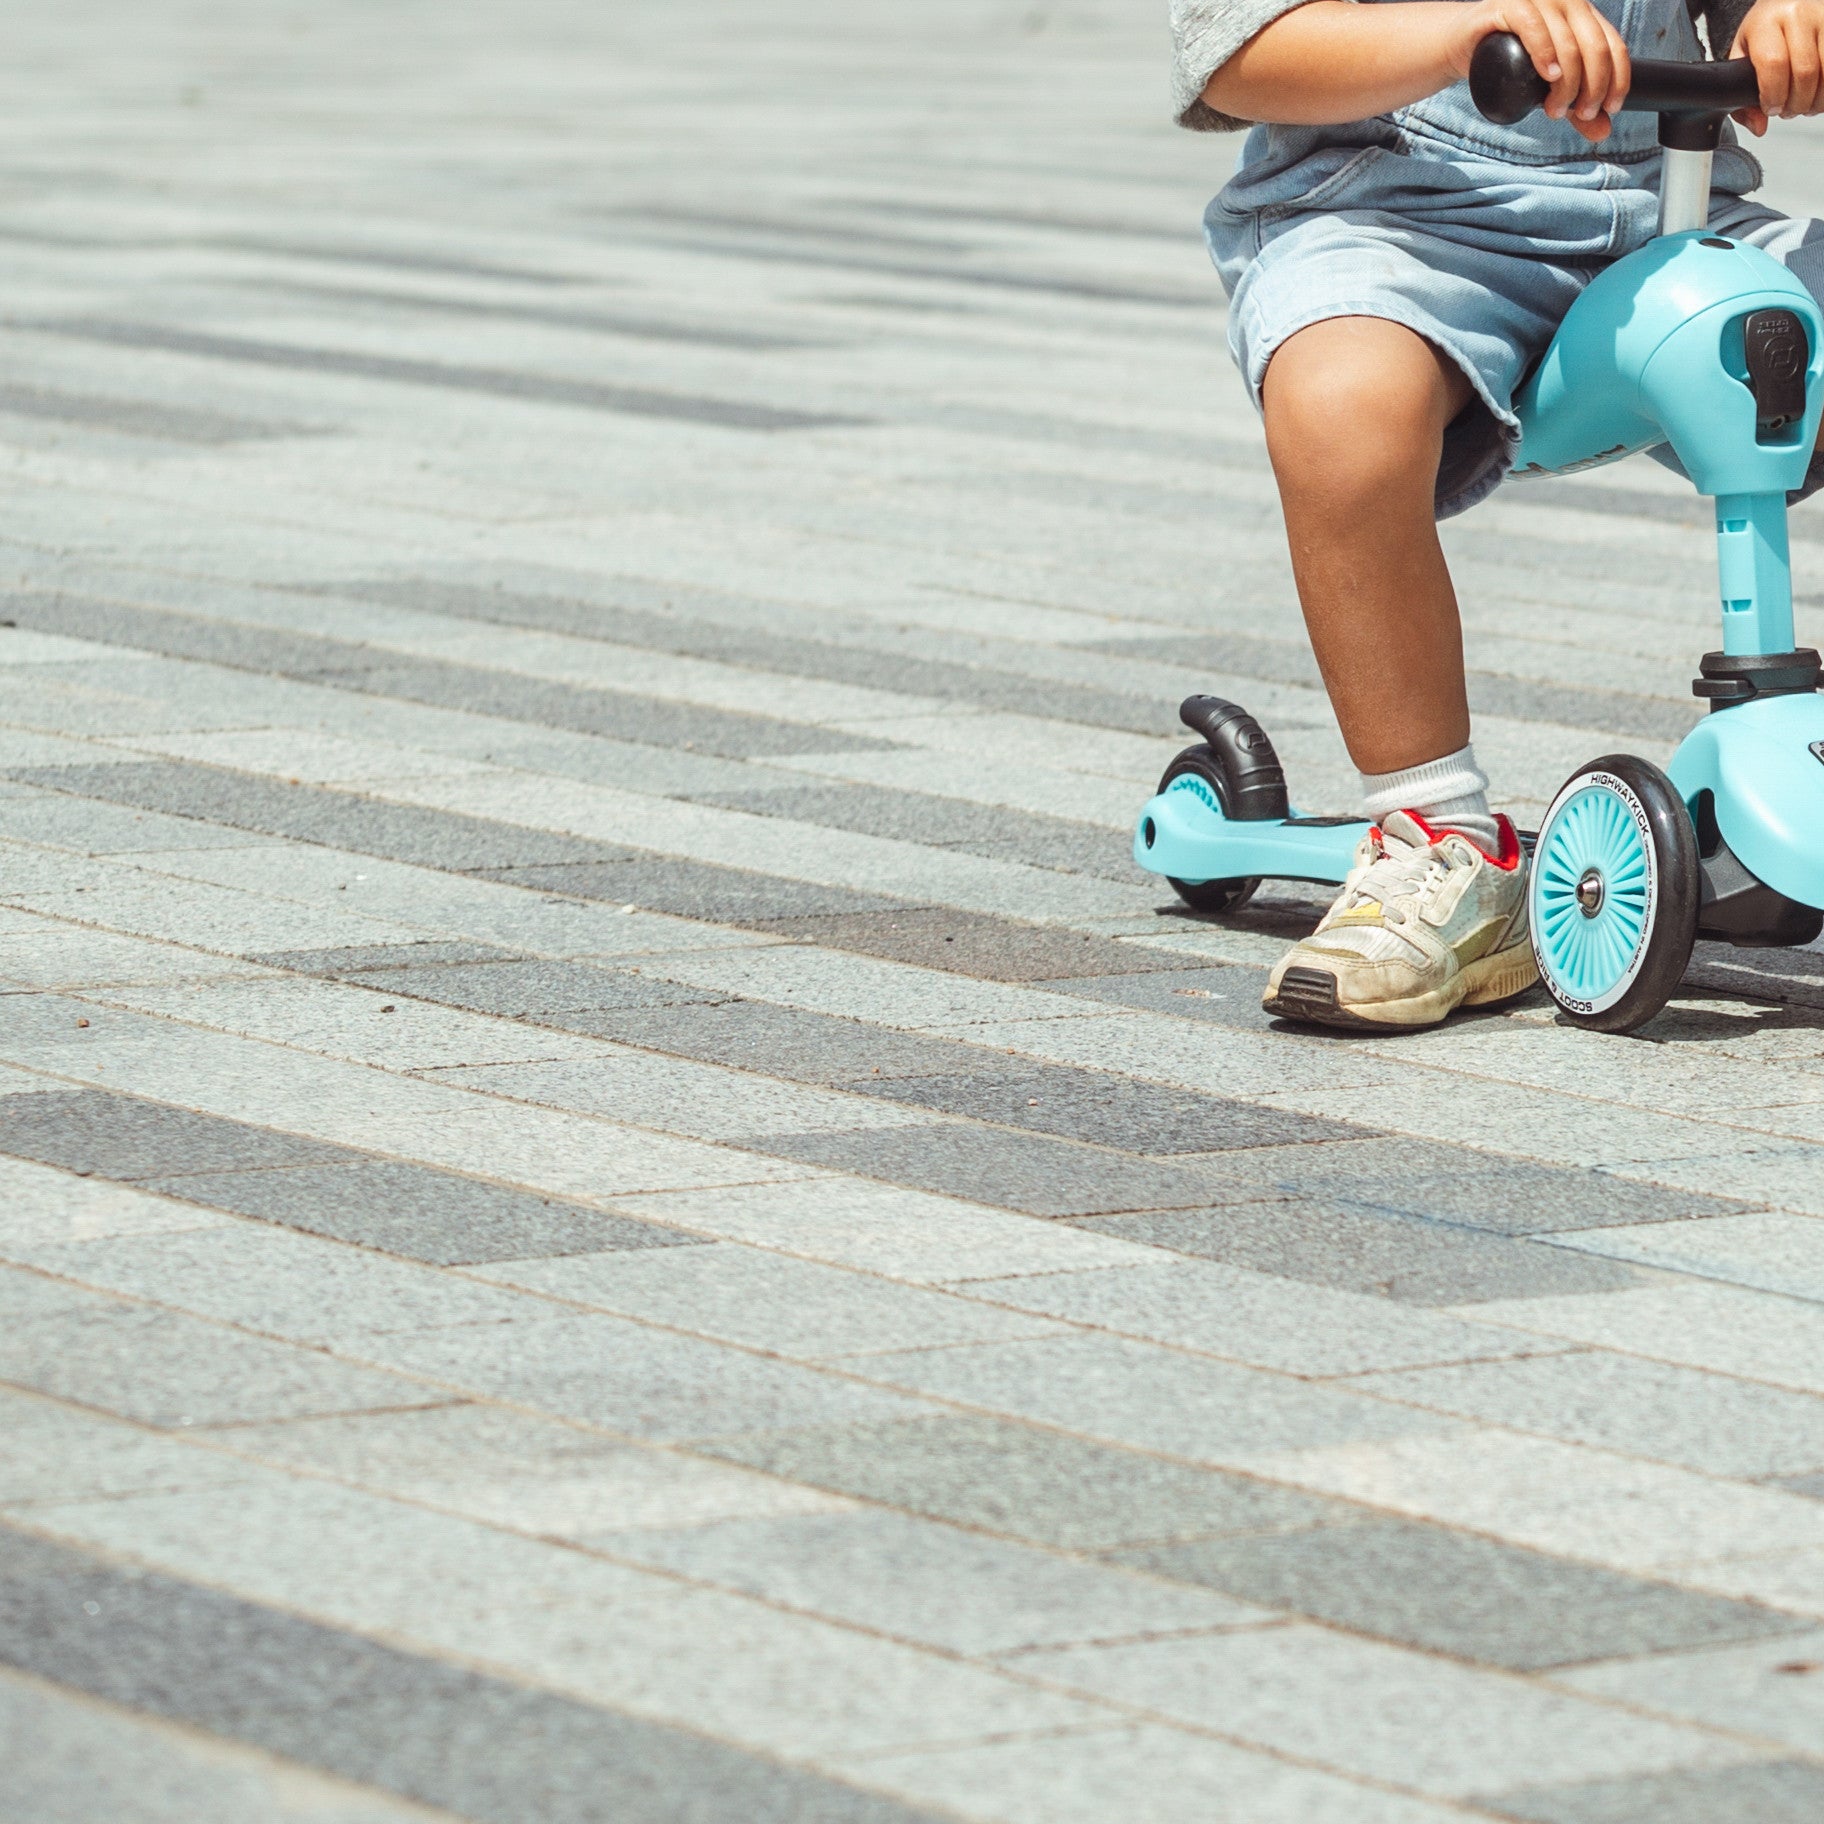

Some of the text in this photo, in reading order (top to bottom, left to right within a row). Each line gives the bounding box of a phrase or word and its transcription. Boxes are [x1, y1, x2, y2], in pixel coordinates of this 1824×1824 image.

[1590, 773, 1650, 837] HIGHWAYKICK
[1534, 945, 1550, 982] RIDE
[1627, 945, 1642, 974] AUSTRIA
[1559, 991, 1593, 1013] SCOOT
